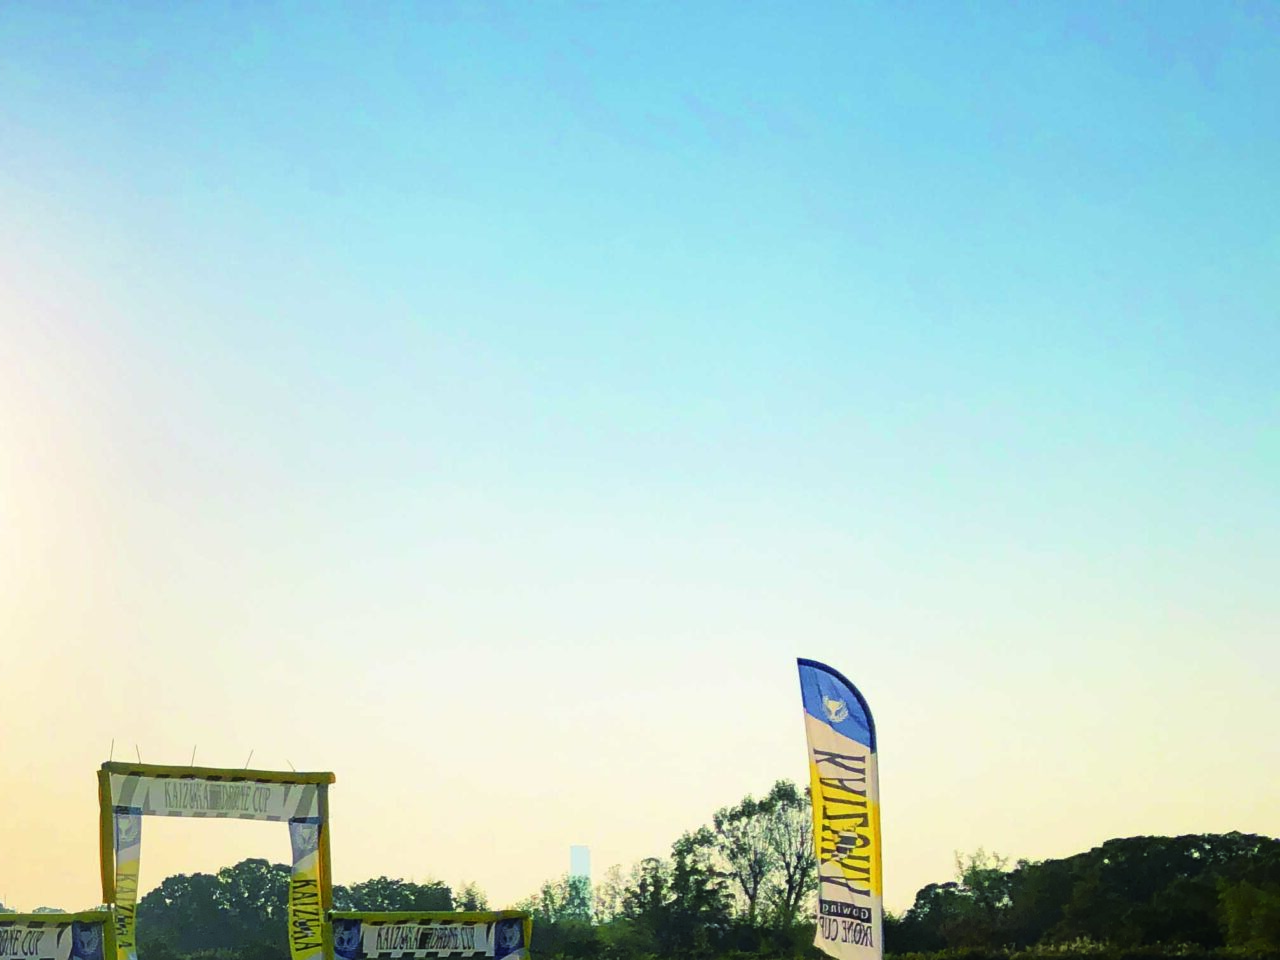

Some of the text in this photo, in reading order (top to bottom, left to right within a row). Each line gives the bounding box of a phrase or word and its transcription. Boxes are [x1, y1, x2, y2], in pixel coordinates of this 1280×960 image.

[252, 786, 271, 812] CUP
[292, 879, 322, 951] KAIZUKA
[21, 930, 45, 956] CUP
[460, 926, 475, 949] CUP
